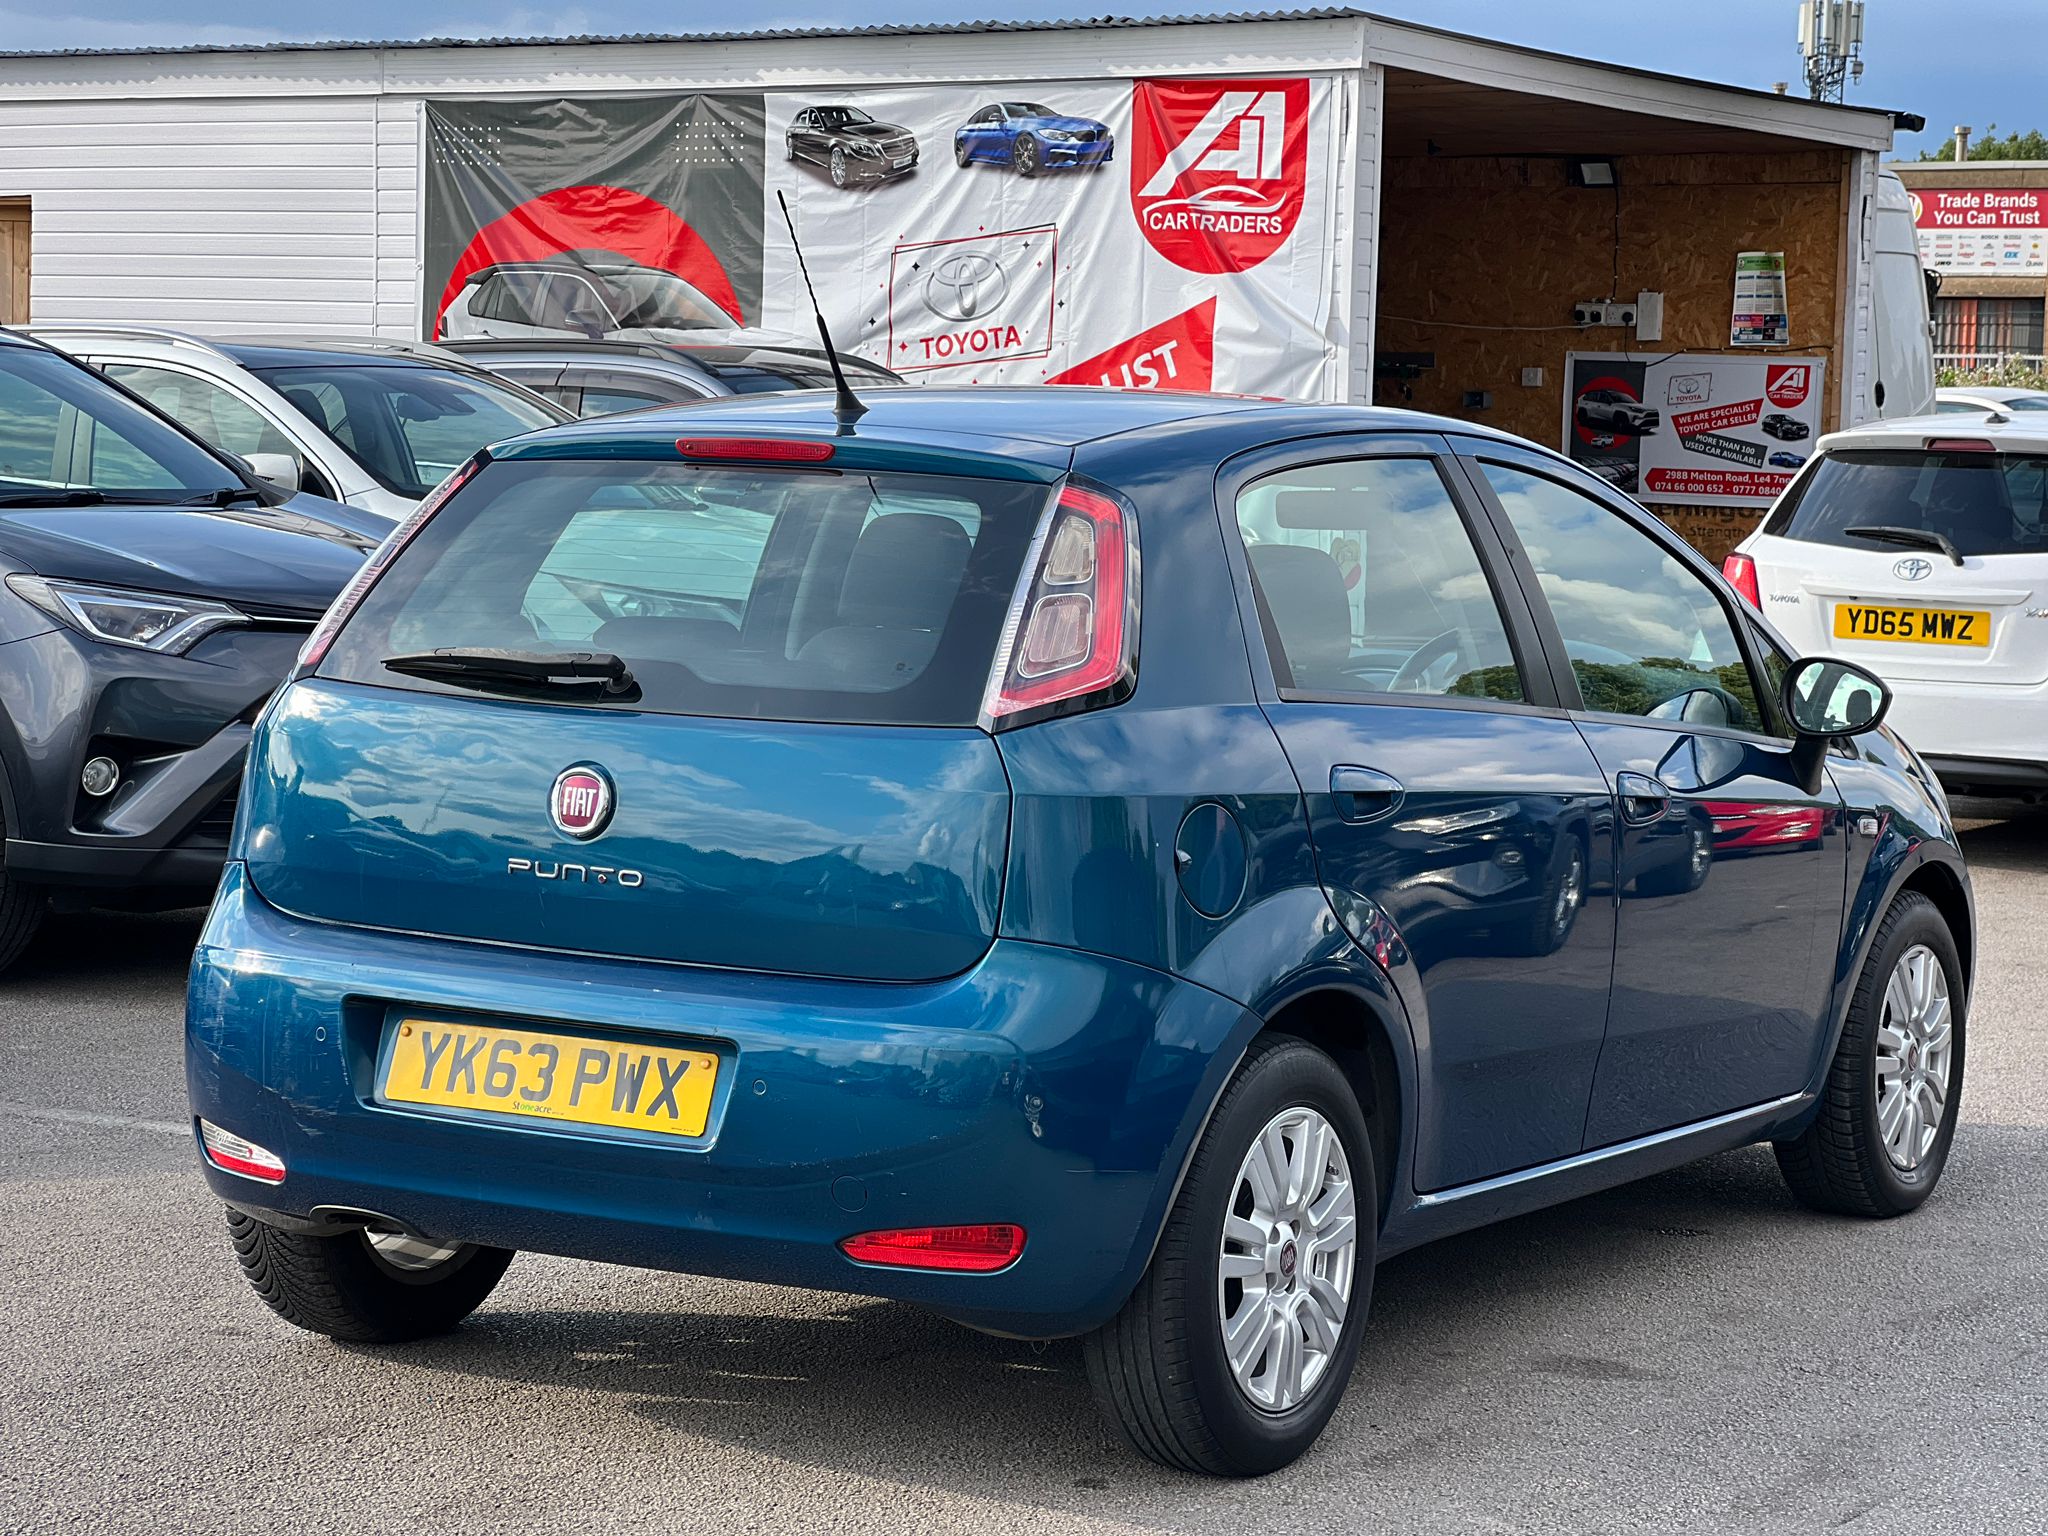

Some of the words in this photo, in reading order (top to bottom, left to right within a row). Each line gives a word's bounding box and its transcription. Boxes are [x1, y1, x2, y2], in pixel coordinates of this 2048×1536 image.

[1938, 192, 1980, 208] Trade
[1984, 192, 2038, 208] Brands
[1934, 210, 1963, 225] You
[1967, 210, 1996, 225] Can
[2000, 210, 2040, 225] Trust
[920, 325, 1022, 359] TOYOTA
[1100, 339, 1179, 389] IST
[1676, 394, 1702, 402] TOYOTA
[1678, 416, 1692, 424] WE
[1693, 411, 1710, 421] ARE
[1711, 403, 1755, 418] SPECIALIST
[1678, 422, 1710, 434] TOYOTA
[1711, 418, 1728, 428] CAR
[1729, 413, 1758, 425] SELLER
[1685, 440, 1705, 451] USED
[1705, 446, 1721, 456] CAR
[1722, 451, 1762, 466] AVAILABLE
[1695, 433, 1717, 445] MORE
[1719, 440, 1740, 451] THAN
[1741, 446, 1755, 455] 100
[1665, 470, 1688, 480] 298B
[1690, 471, 1723, 481] Melton
[1725, 473, 1751, 484] Road,
[1754, 474, 1771, 483] Le4
[1655, 482, 1672, 490] 074
[1674, 482, 1685, 491] 66
[1687, 483, 1705, 492] 000
[1706, 484, 1724, 493] 652
[1733, 485, 1756, 494] 0777
[1848, 608, 1914, 637] YD65
[1921, 612, 1974, 640] MWZ
[562, 786, 598, 818] FIAT
[507, 857, 644, 887] PUNTO
[420, 1031, 560, 1102] YK63
[569, 1047, 690, 1119] PWX
[512, 1100, 552, 1114] Stoneacre
